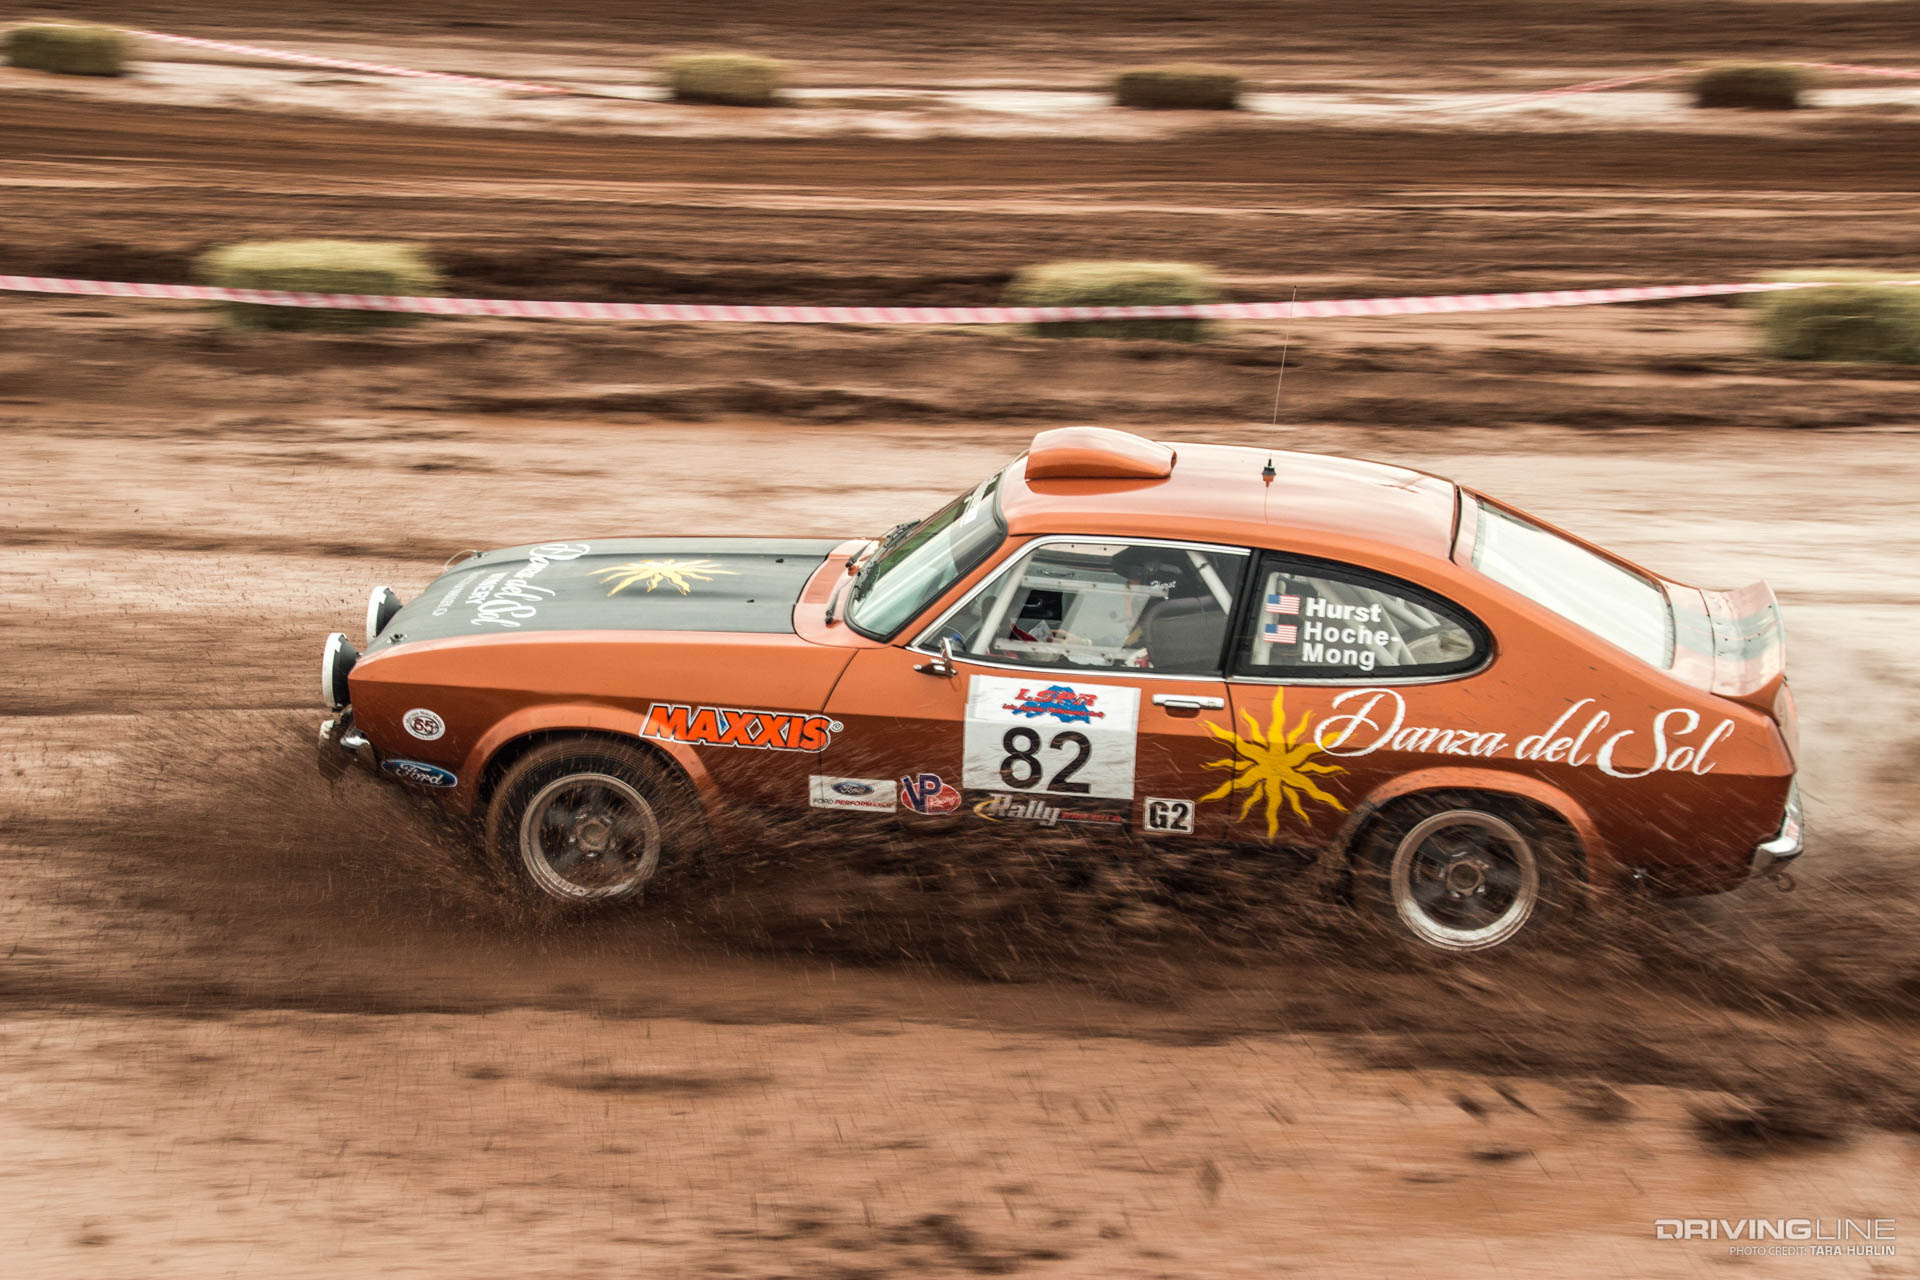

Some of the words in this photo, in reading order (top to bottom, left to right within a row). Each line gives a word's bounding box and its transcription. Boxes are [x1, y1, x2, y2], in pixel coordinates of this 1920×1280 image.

[470, 599, 537, 628] Sol
[1305, 596, 1382, 623] Hurst
[1303, 620, 1400, 648] Hoche-
[1301, 641, 1376, 672] Mong
[1313, 687, 1508, 758] Danza
[1515, 697, 1610, 767] del
[1597, 707, 1735, 779] Sol
[395, 761, 444, 786] Ford
[999, 727, 1093, 794] 82
[901, 773, 943, 814] VP
[986, 792, 1062, 827] Rally
[1149, 801, 1189, 831] G2
